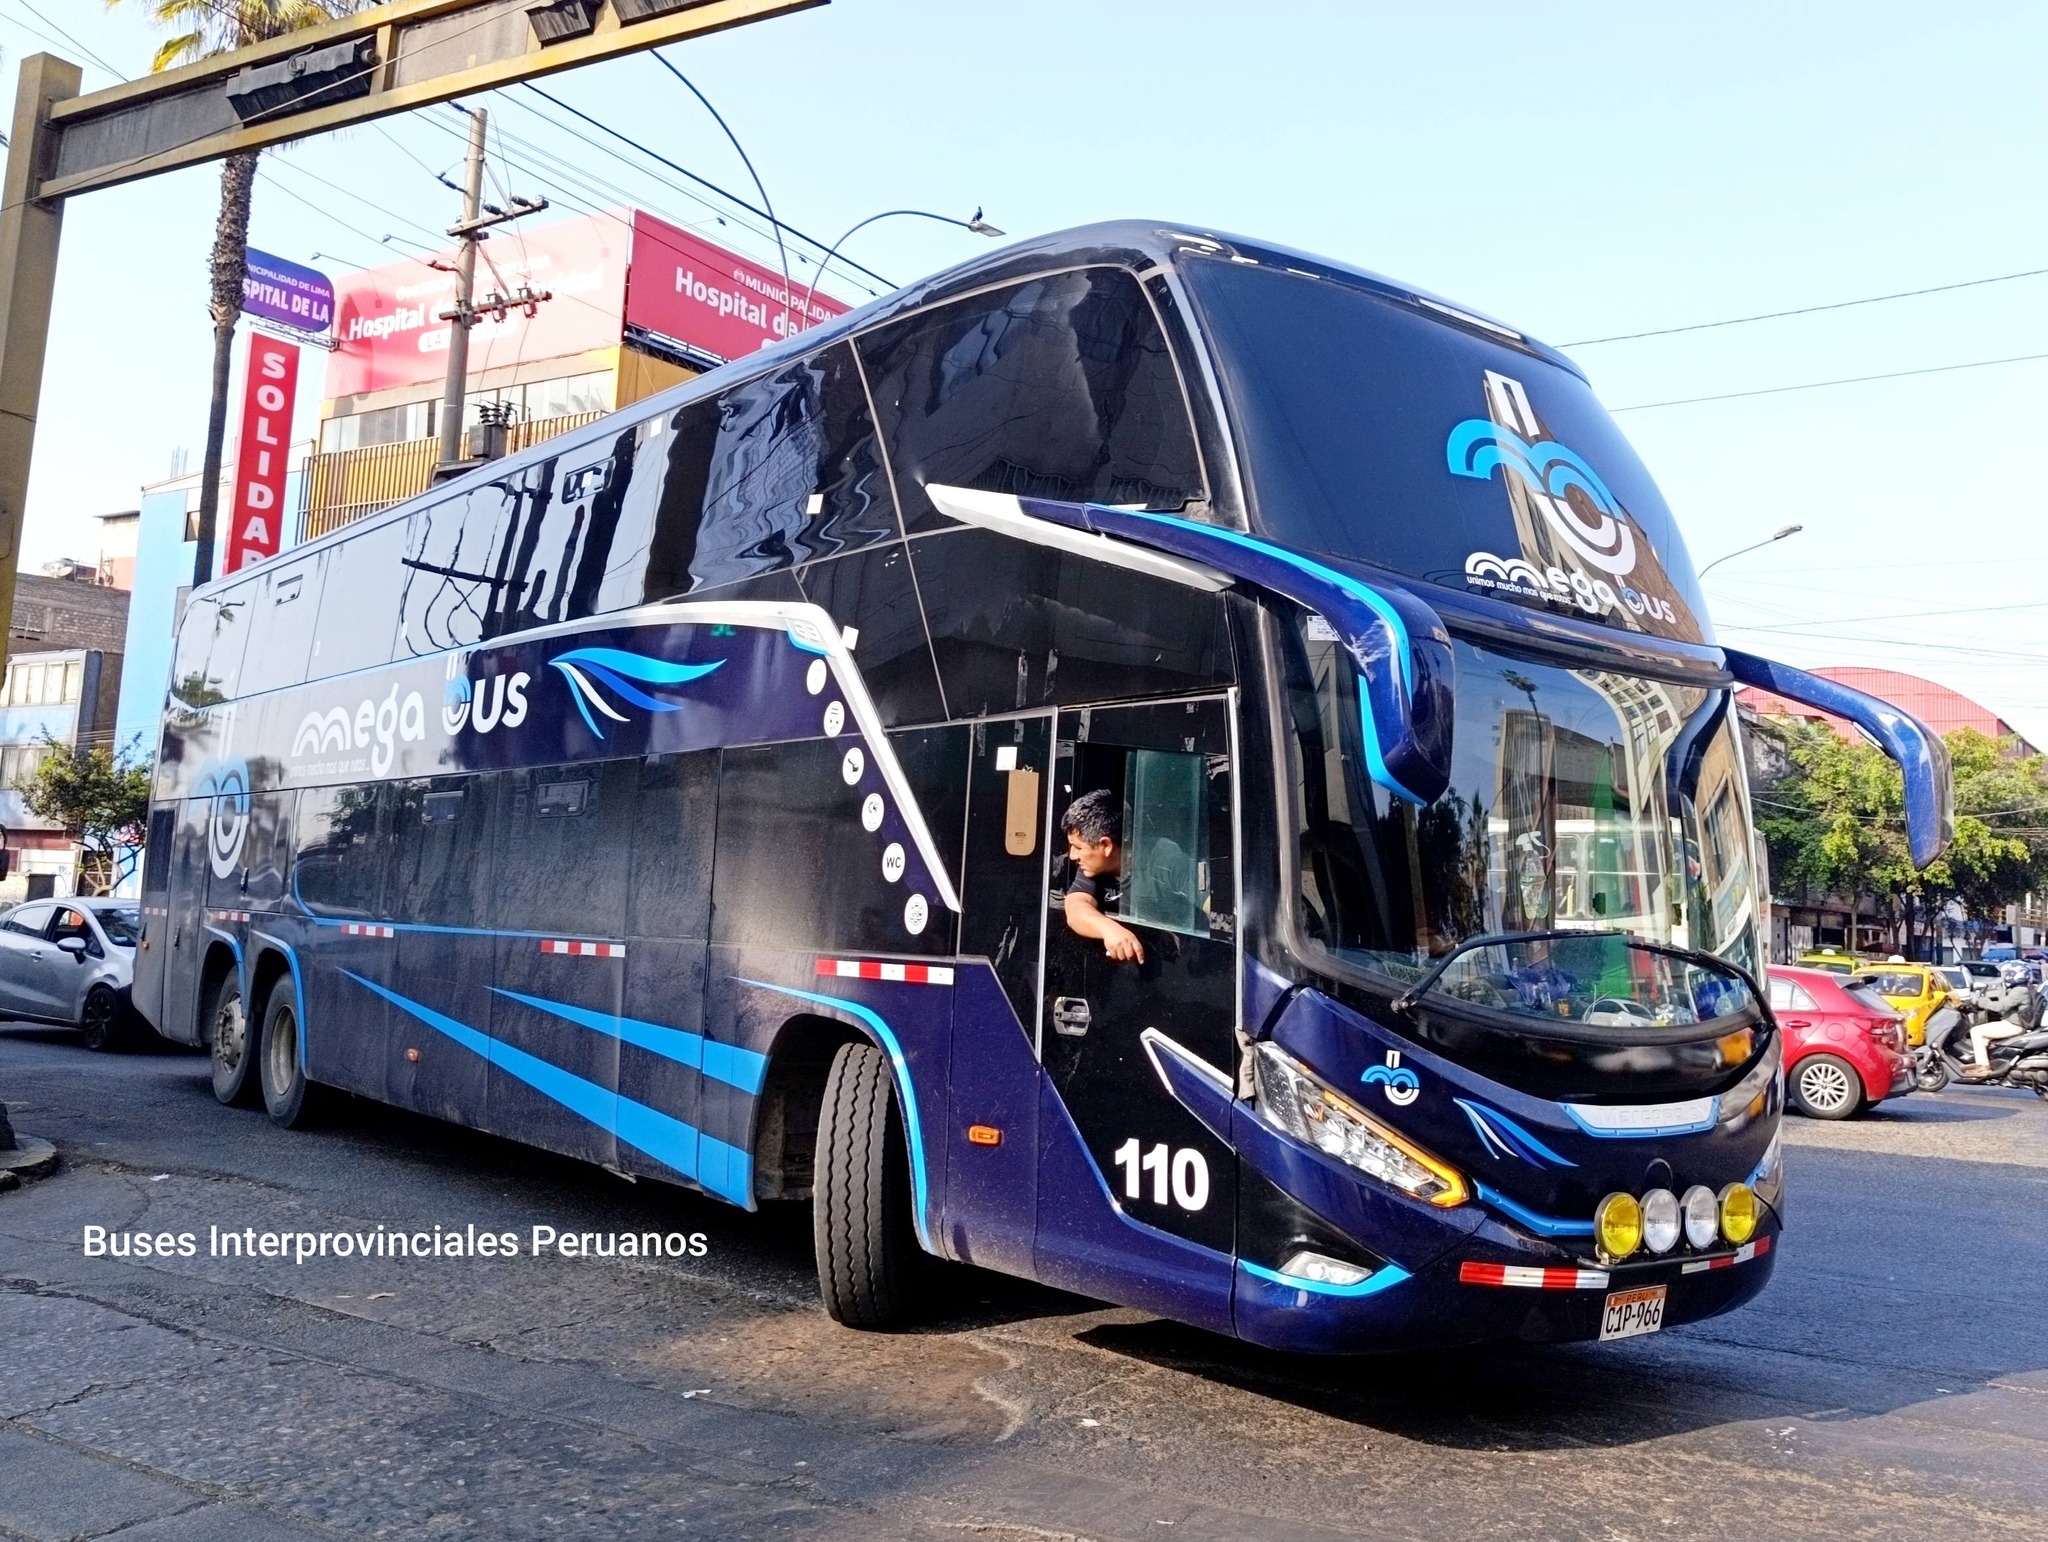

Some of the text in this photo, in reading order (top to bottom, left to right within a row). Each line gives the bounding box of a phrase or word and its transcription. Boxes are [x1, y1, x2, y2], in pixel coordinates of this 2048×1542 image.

[247, 263, 330, 298] NICIPALIDAD DE LIMA
[675, 266, 768, 329] Hospital
[242, 277, 329, 323] SPITAL DE LA
[348, 302, 426, 341] Hospital
[1466, 575, 1496, 588] unimos
[1496, 581, 1522, 594] mucho
[291, 651, 531, 778] mega bus
[886, 856, 901, 869] WC
[1115, 1138, 1209, 1211] 110
[1605, 1299, 1662, 1334] C1P-966
[1626, 1292, 1648, 1304] PERU
